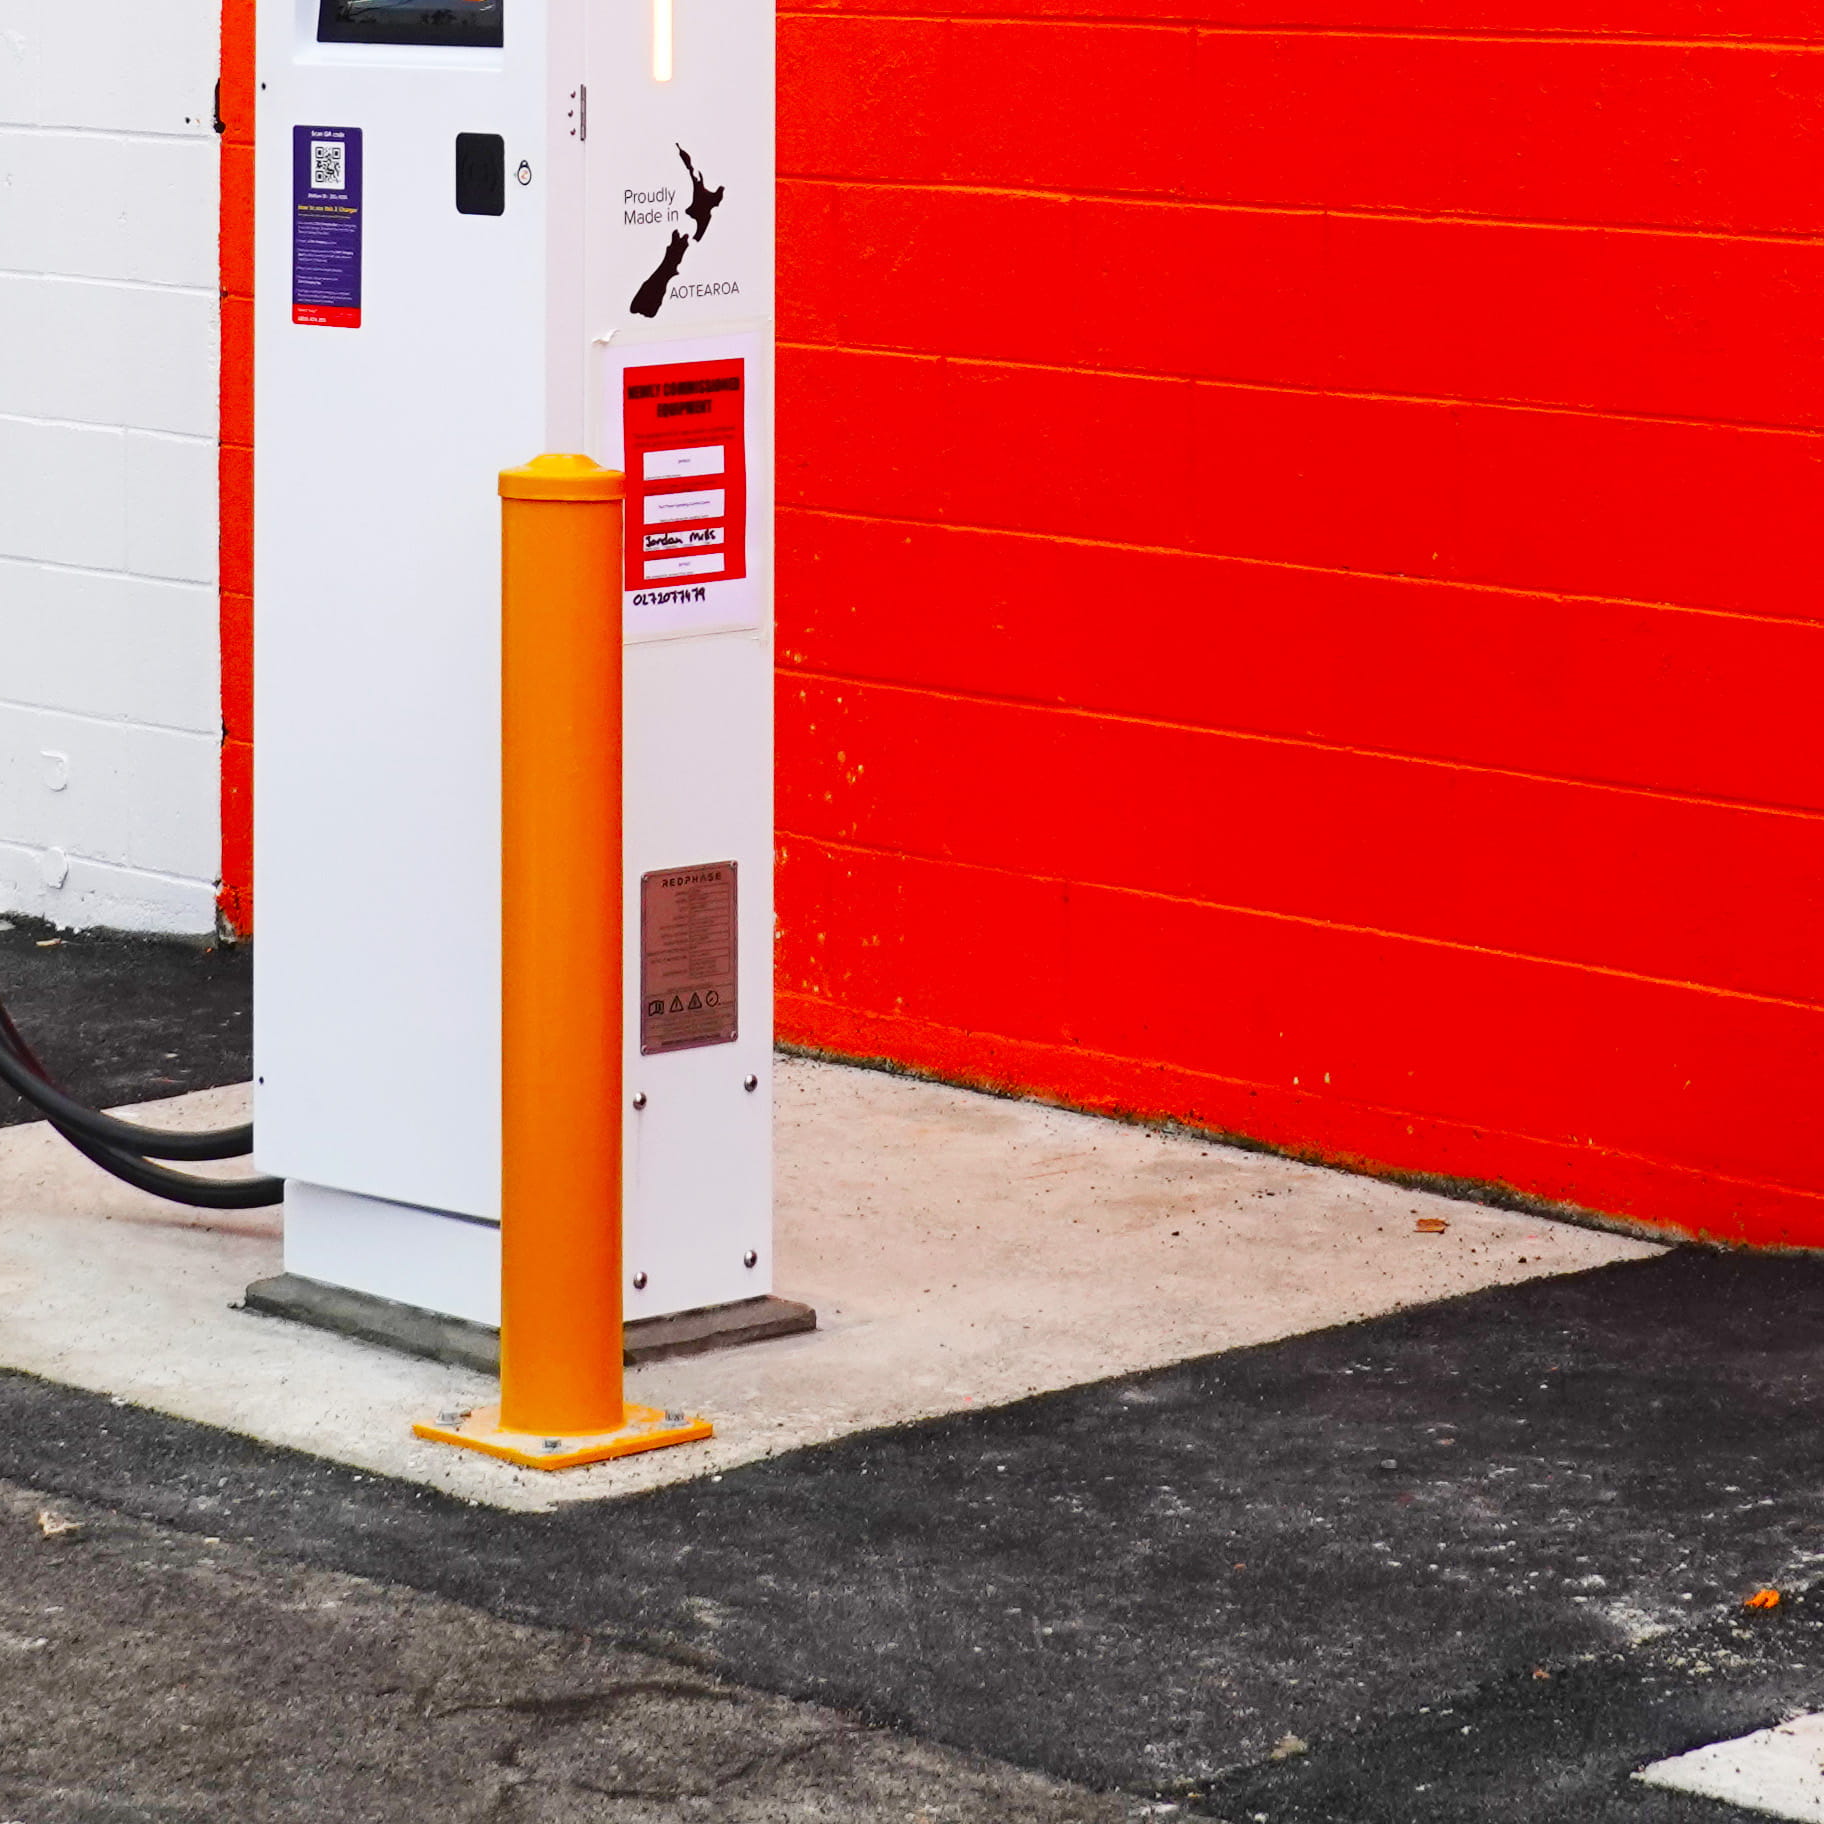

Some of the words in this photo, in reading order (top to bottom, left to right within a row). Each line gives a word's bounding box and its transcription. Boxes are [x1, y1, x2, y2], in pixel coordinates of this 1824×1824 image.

[624, 187, 676, 205] Proudly
[624, 209, 663, 225] Made
[667, 207, 679, 222] in
[670, 281, 740, 299] AOTEAROA
[645, 533, 683, 547] Jordan
[662, 872, 722, 888] REDPHASE
